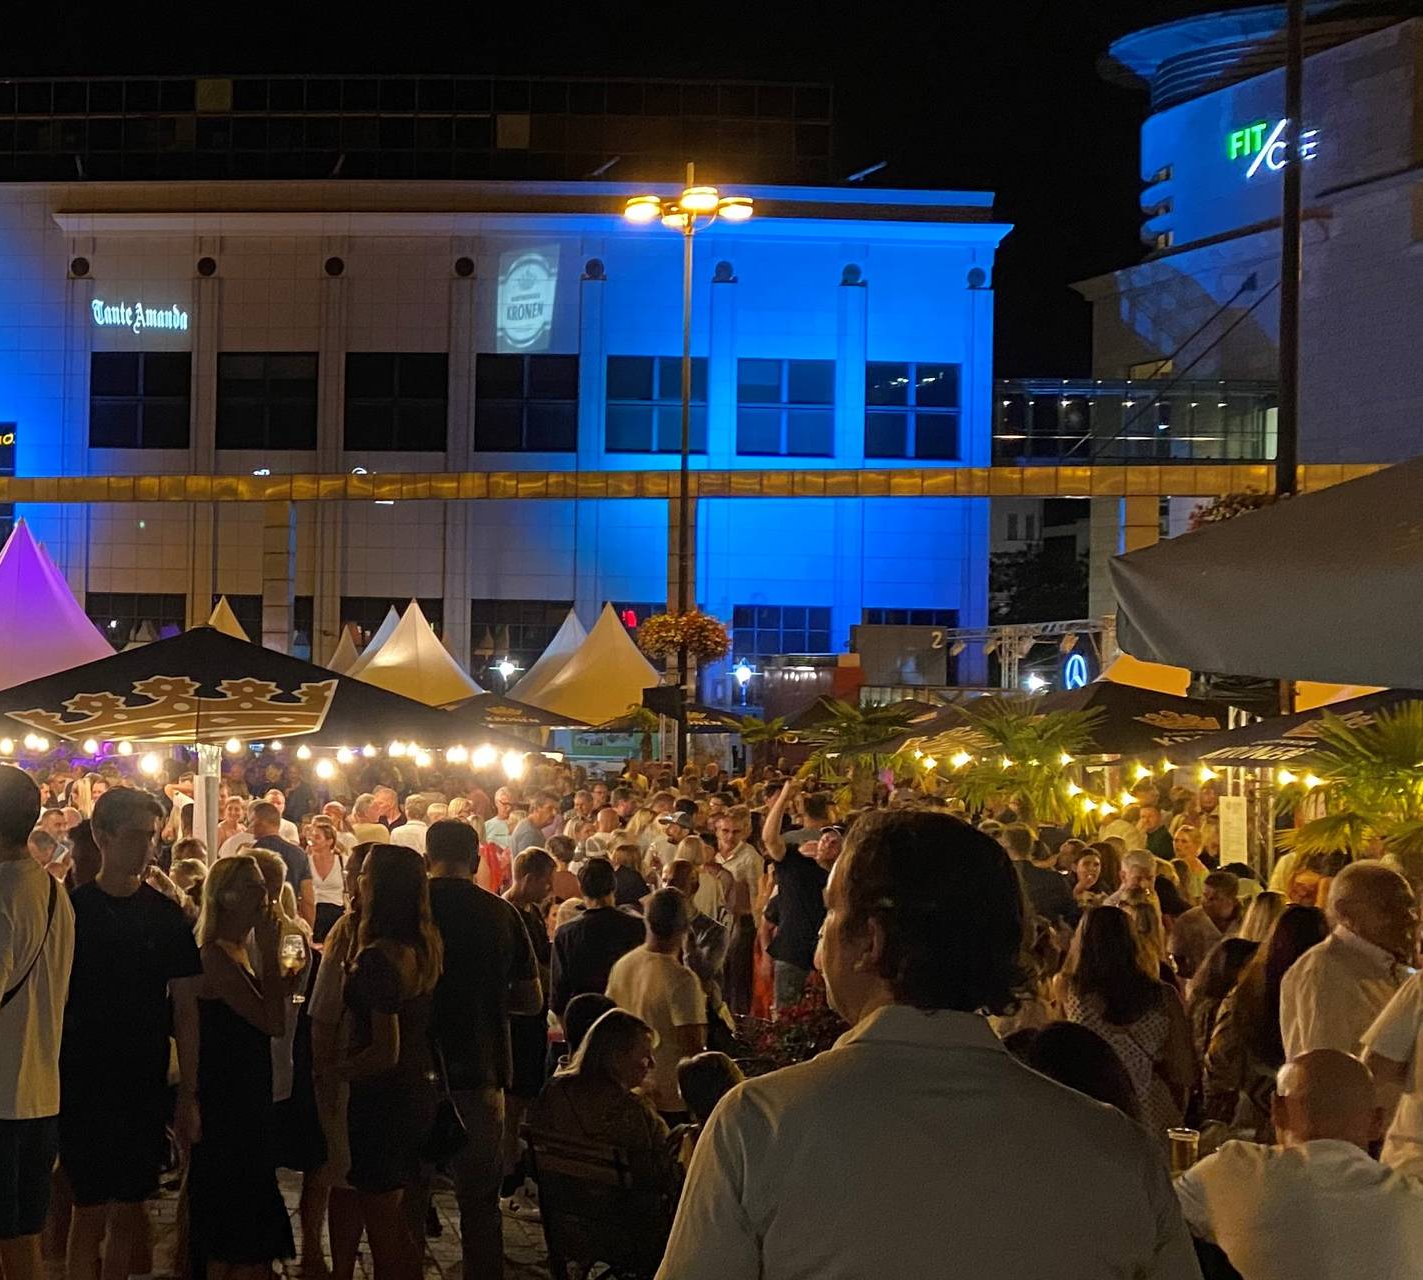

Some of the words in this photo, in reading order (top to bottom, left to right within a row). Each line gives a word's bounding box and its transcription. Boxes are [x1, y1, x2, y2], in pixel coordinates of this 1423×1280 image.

[91, 299, 133, 326] Tante
[133, 302, 188, 334] Amanda
[506, 302, 545, 321] KRONEN
[931, 631, 943, 649] 2
